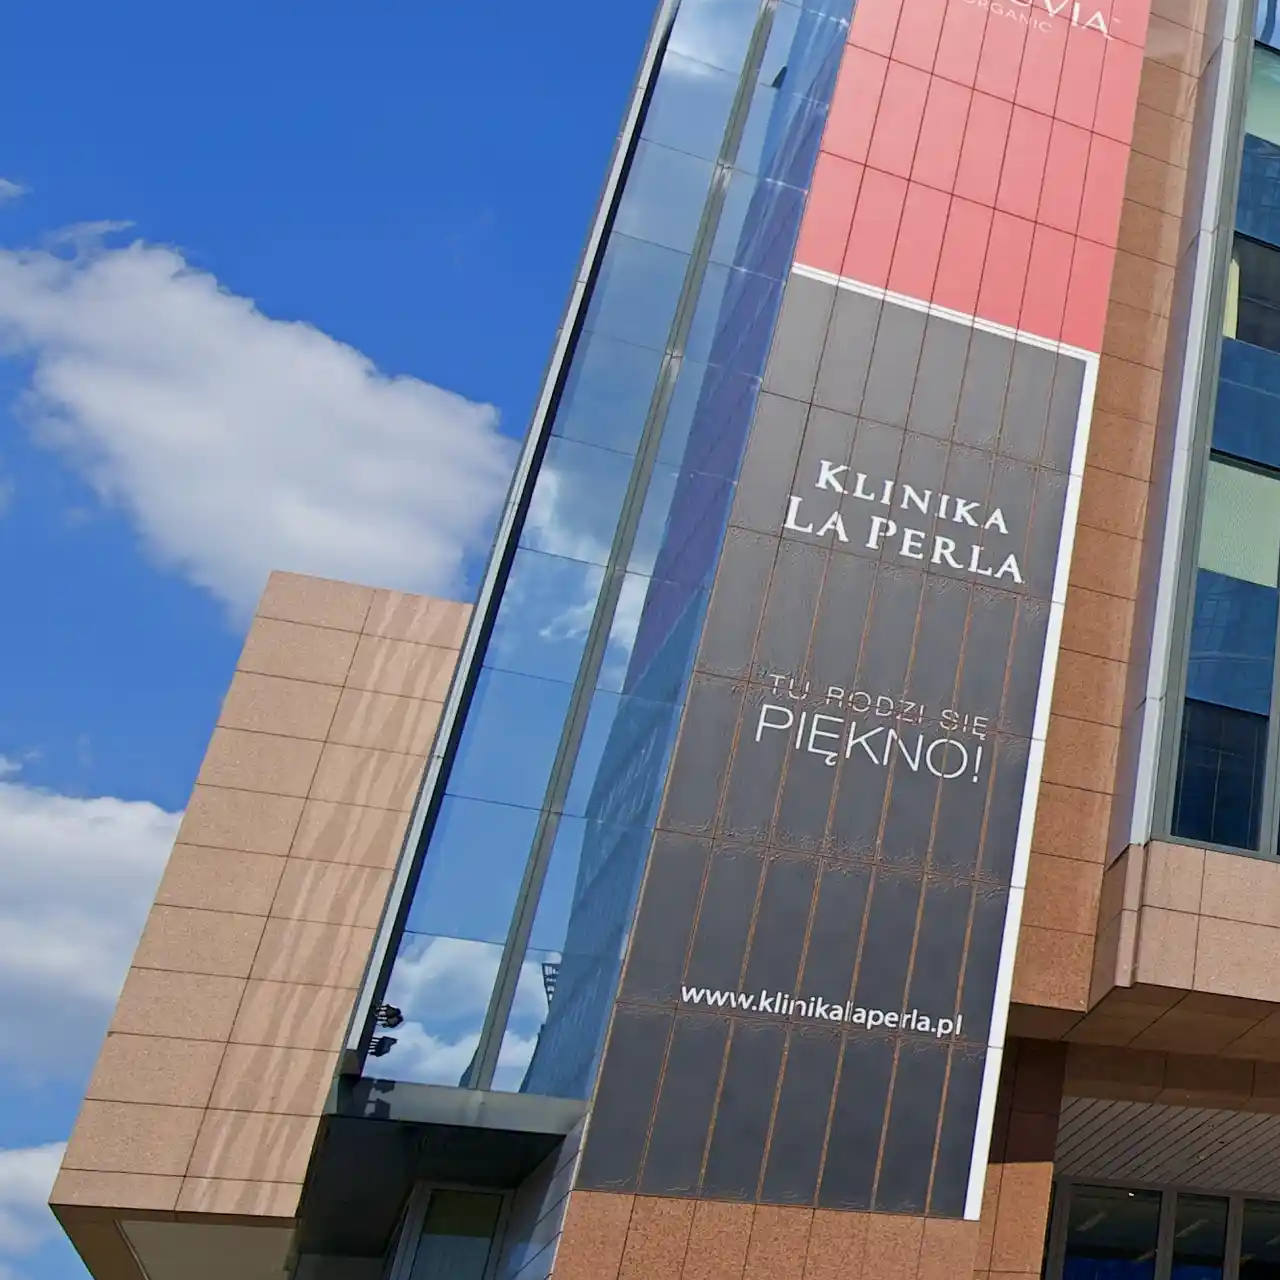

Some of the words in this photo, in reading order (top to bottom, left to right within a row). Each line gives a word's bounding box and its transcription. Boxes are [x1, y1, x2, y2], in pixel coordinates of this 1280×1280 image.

[815, 460, 1010, 534] KLINIKA
[782, 495, 849, 543] LA
[865, 515, 1026, 584] PERLA
[755, 704, 983, 783] PIĘKNO!
[769, 674, 811, 700] TU
[826, 686, 925, 724] RODZI
[939, 709, 989, 741] SIĘ
[681, 986, 963, 1038] www.klinikalaperla.pl
